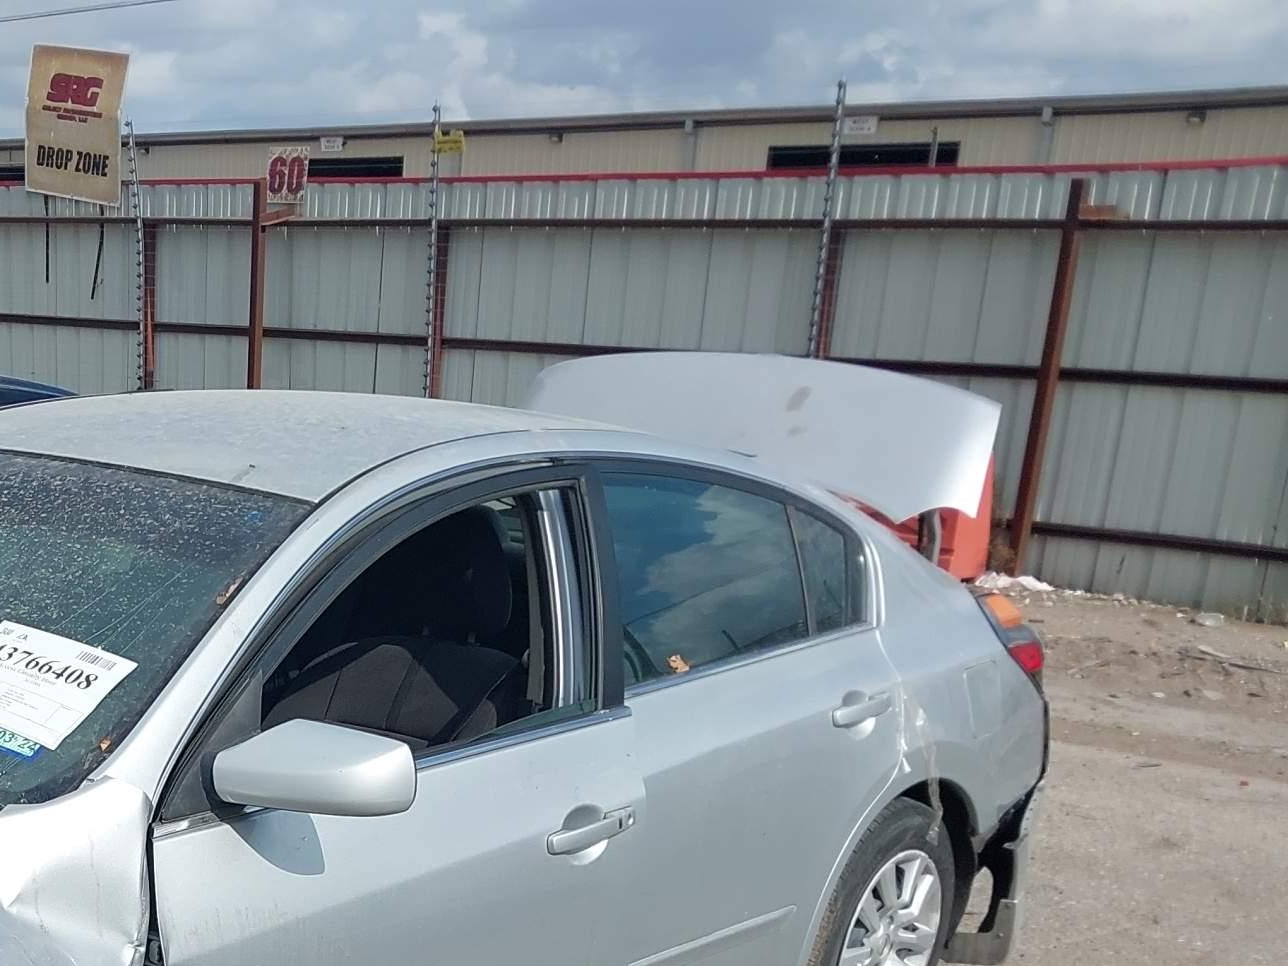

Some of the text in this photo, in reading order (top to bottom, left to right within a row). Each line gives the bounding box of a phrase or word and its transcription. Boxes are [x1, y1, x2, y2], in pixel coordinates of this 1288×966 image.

[46, 72, 104, 107] SRG
[36, 144, 110, 178] DROP ZONE
[268, 155, 306, 195] 60
